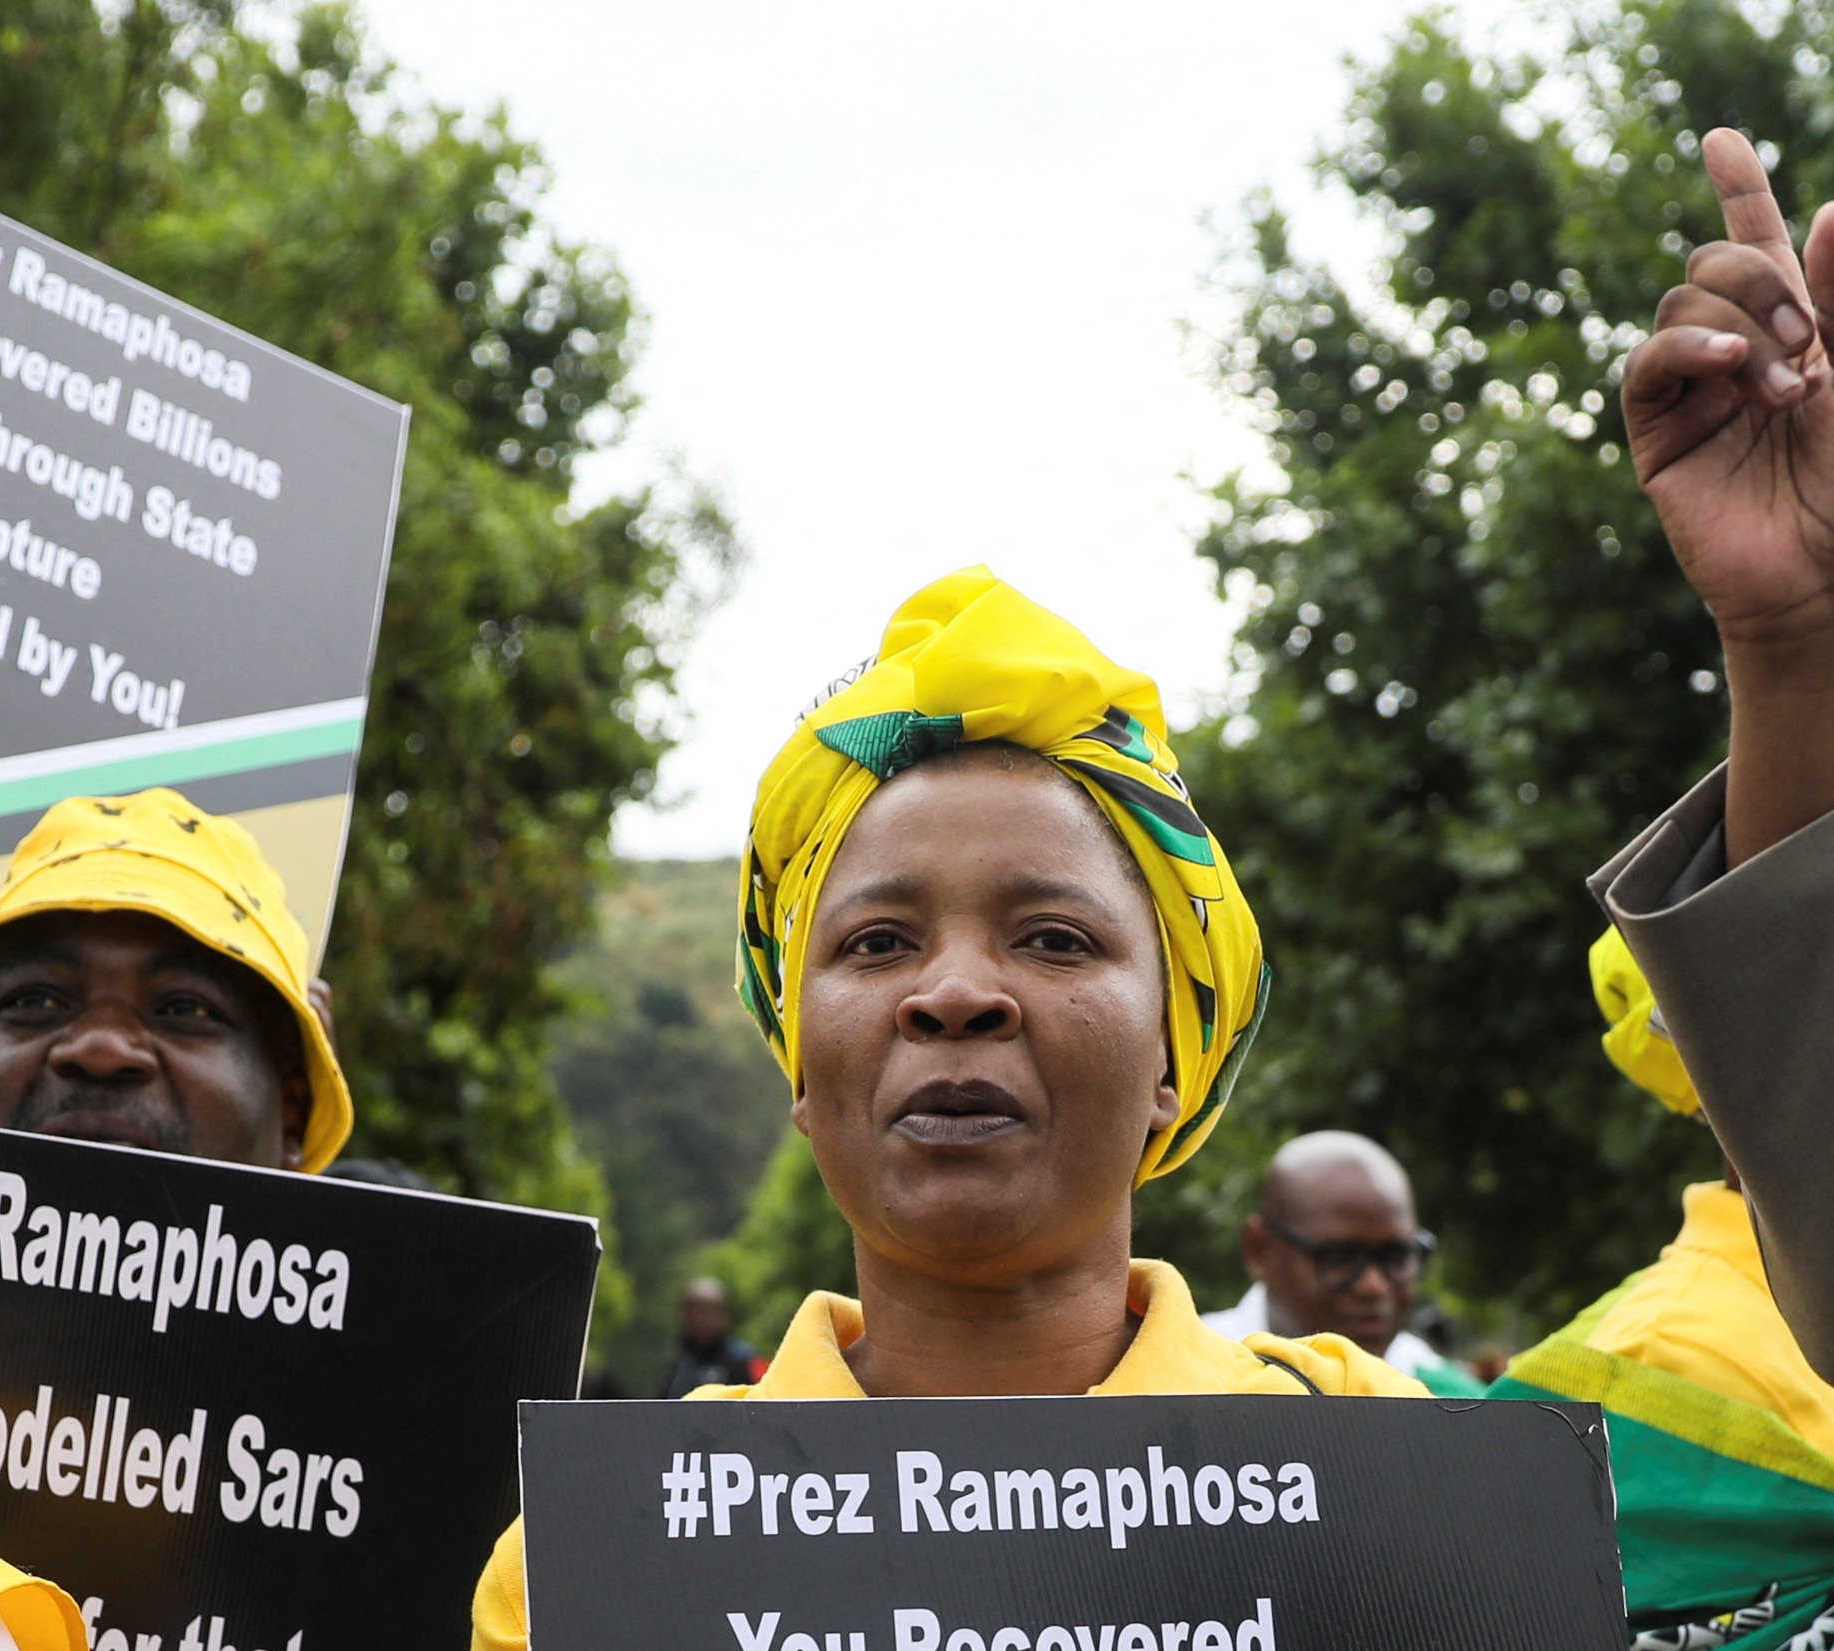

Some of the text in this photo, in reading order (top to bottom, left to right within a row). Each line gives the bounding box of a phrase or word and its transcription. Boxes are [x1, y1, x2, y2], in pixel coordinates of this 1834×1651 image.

[9, 246, 252, 403] Ramaphosa
[126, 388, 282, 500] Billions
[142, 486, 258, 576] State
[17, 617, 77, 696] by
[90, 644, 185, 729] You!
[221, 1415, 362, 1536] Sars
[662, 1446, 1320, 1549] #Prez Ramaphosa
